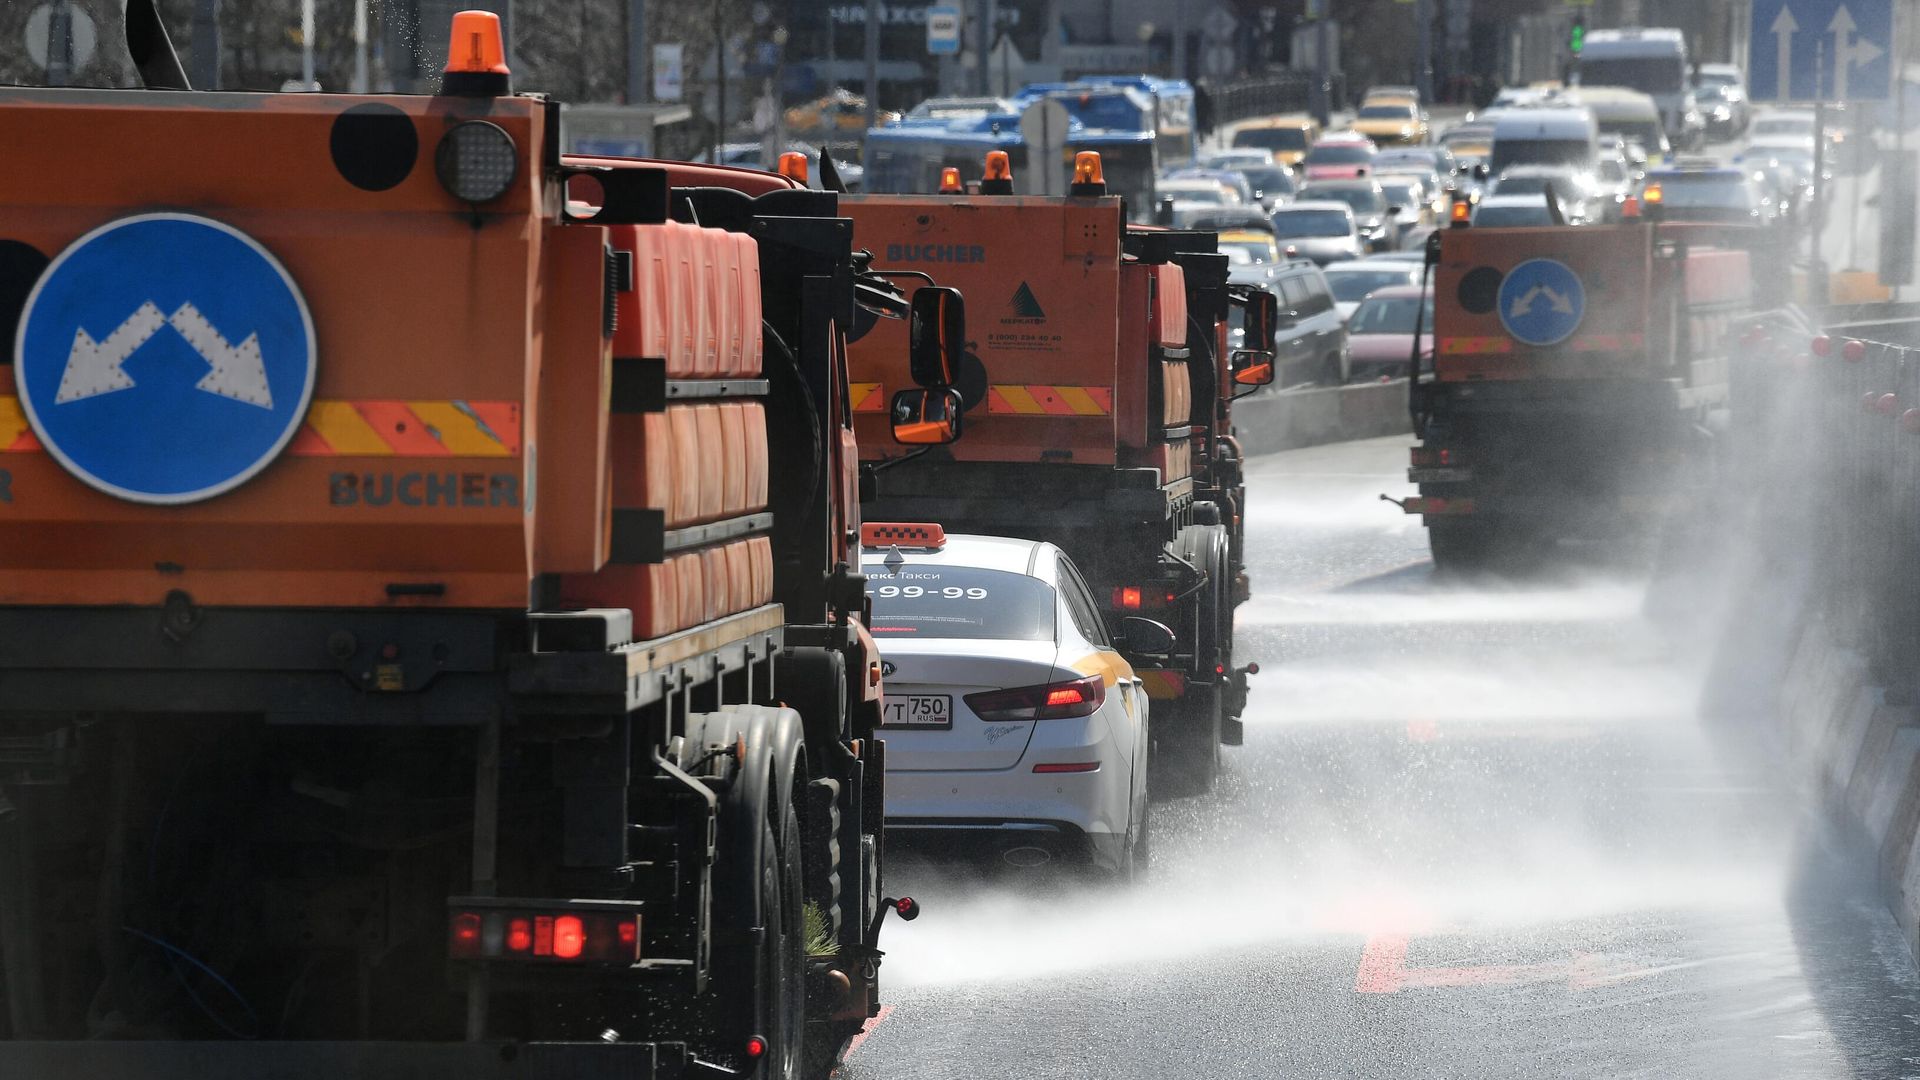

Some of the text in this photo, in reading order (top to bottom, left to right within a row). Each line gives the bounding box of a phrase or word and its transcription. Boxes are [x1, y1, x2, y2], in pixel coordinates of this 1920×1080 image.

[887, 244, 984, 262] BUCHER
[329, 473, 519, 507] BUCHER
[899, 571, 940, 579] Такси
[910, 698, 943, 715] 750
